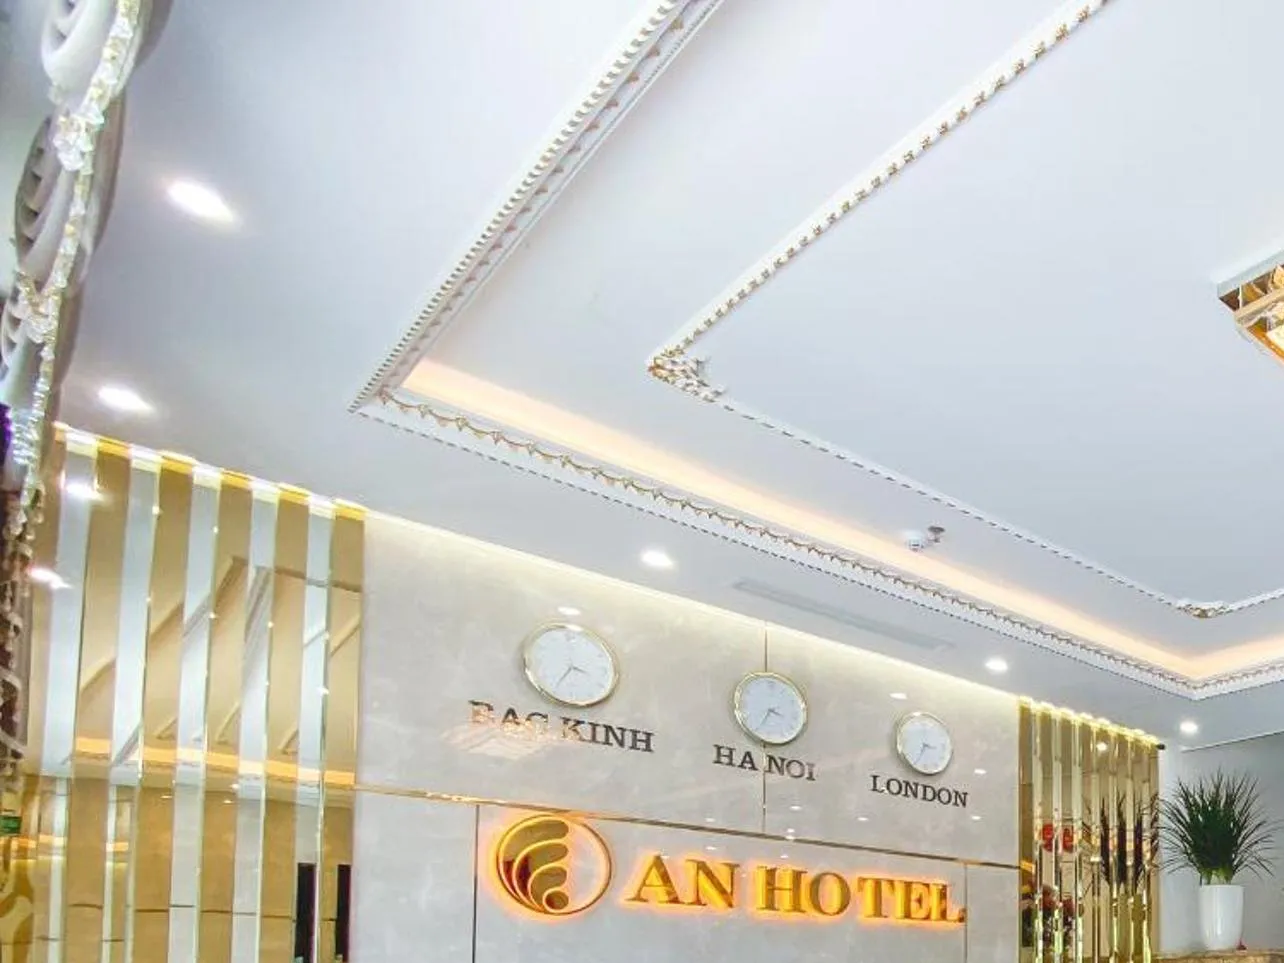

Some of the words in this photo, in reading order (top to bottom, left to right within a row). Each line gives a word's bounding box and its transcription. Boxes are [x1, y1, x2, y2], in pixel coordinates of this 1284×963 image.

[559, 716, 656, 753] KINH
[713, 744, 757, 772] HA
[763, 754, 816, 782] NOI
[870, 774, 969, 808] LONDON
[625, 853, 740, 910] AN
[756, 866, 966, 923] HOTEL
